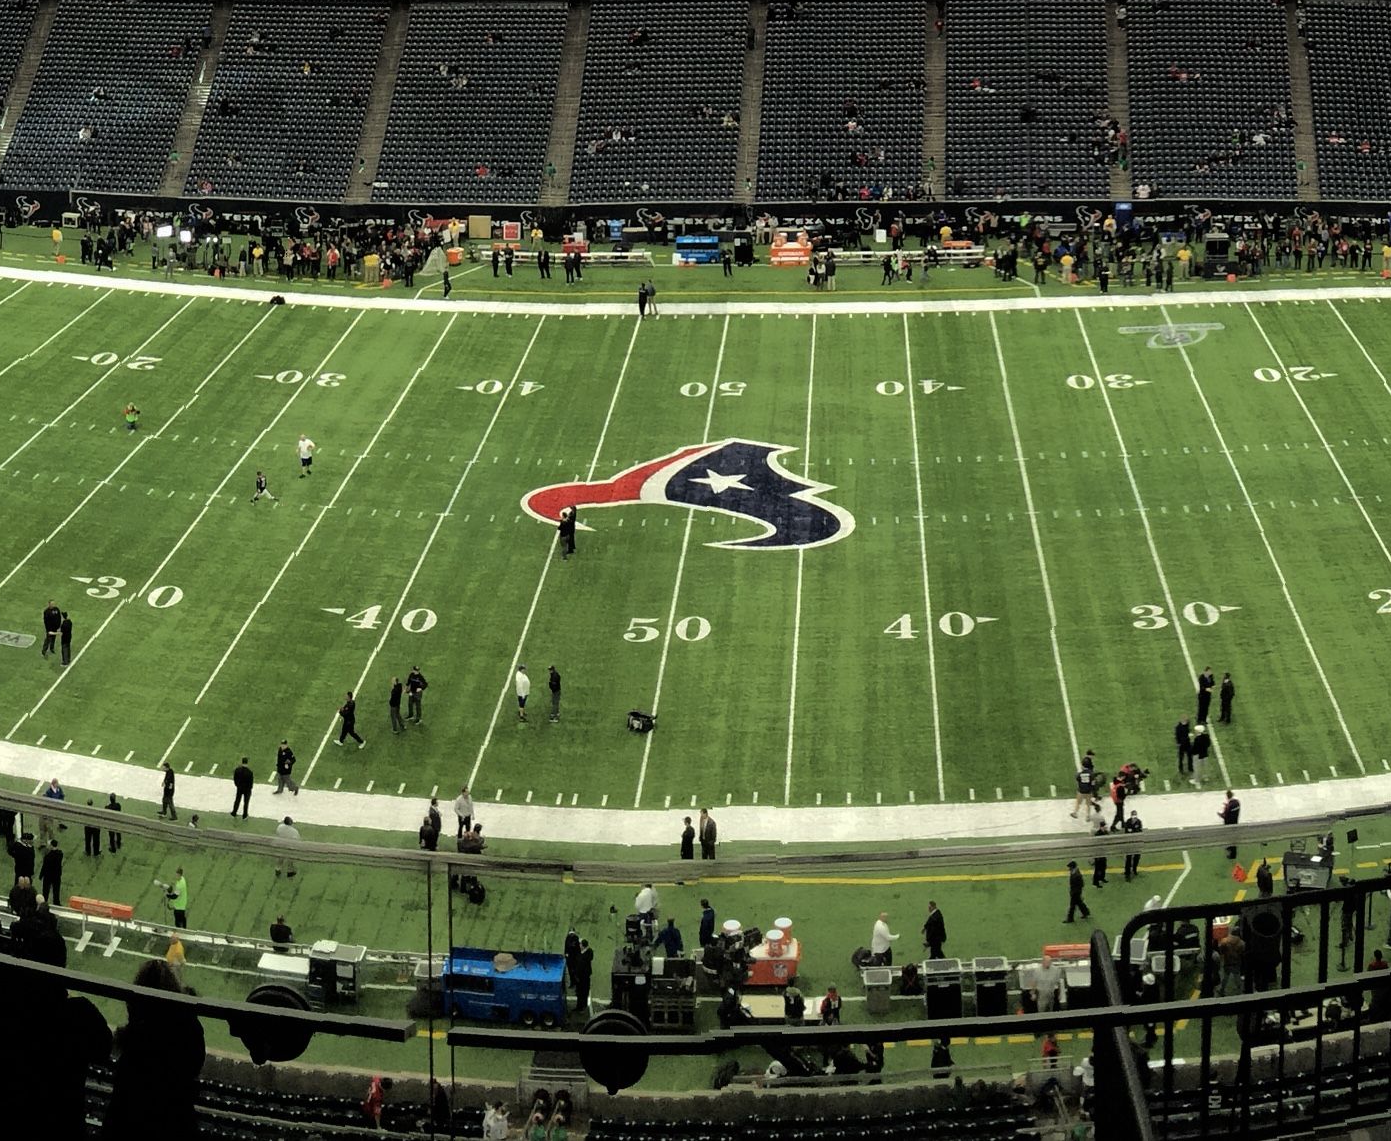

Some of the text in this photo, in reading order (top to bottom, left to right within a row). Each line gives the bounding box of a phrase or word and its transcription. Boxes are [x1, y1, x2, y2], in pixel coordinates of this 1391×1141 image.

[91, 351, 163, 371] 20
[276, 369, 347, 389] 30
[1066, 373, 1135, 390] 30
[1253, 365, 1321, 383] 20
[475, 378, 546, 396] 40
[679, 380, 747, 398] 50
[875, 378, 945, 396] 40
[88, 575, 184, 610] 30
[344, 603, 439, 634] 40
[883, 611, 976, 640] 40
[1131, 600, 1221, 631] 30
[622, 616, 712, 643] 50
